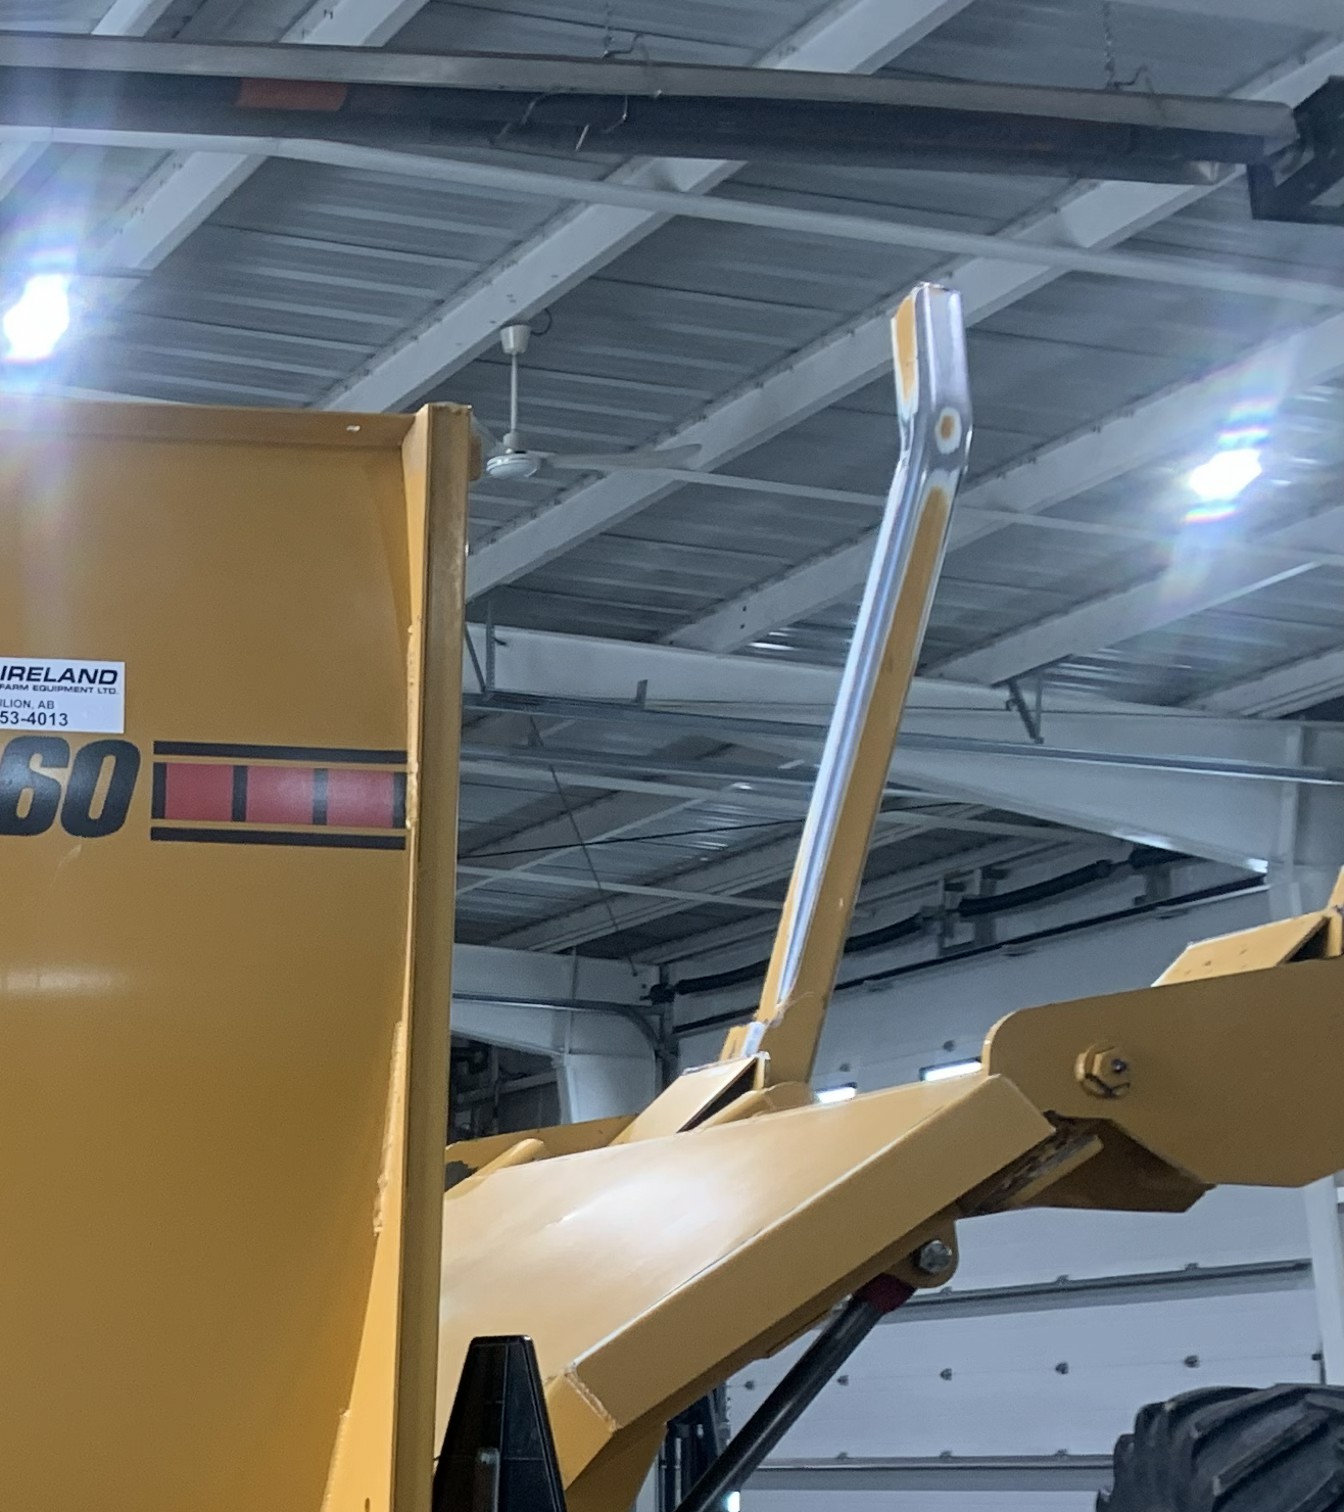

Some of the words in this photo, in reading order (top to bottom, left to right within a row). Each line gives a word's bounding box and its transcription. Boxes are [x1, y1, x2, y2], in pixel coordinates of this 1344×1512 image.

[0, 664, 118, 686] IRELAND
[32, 684, 95, 694] EQUIPMENT
[97, 686, 120, 695] LTD.
[38, 699, 55, 710] AB
